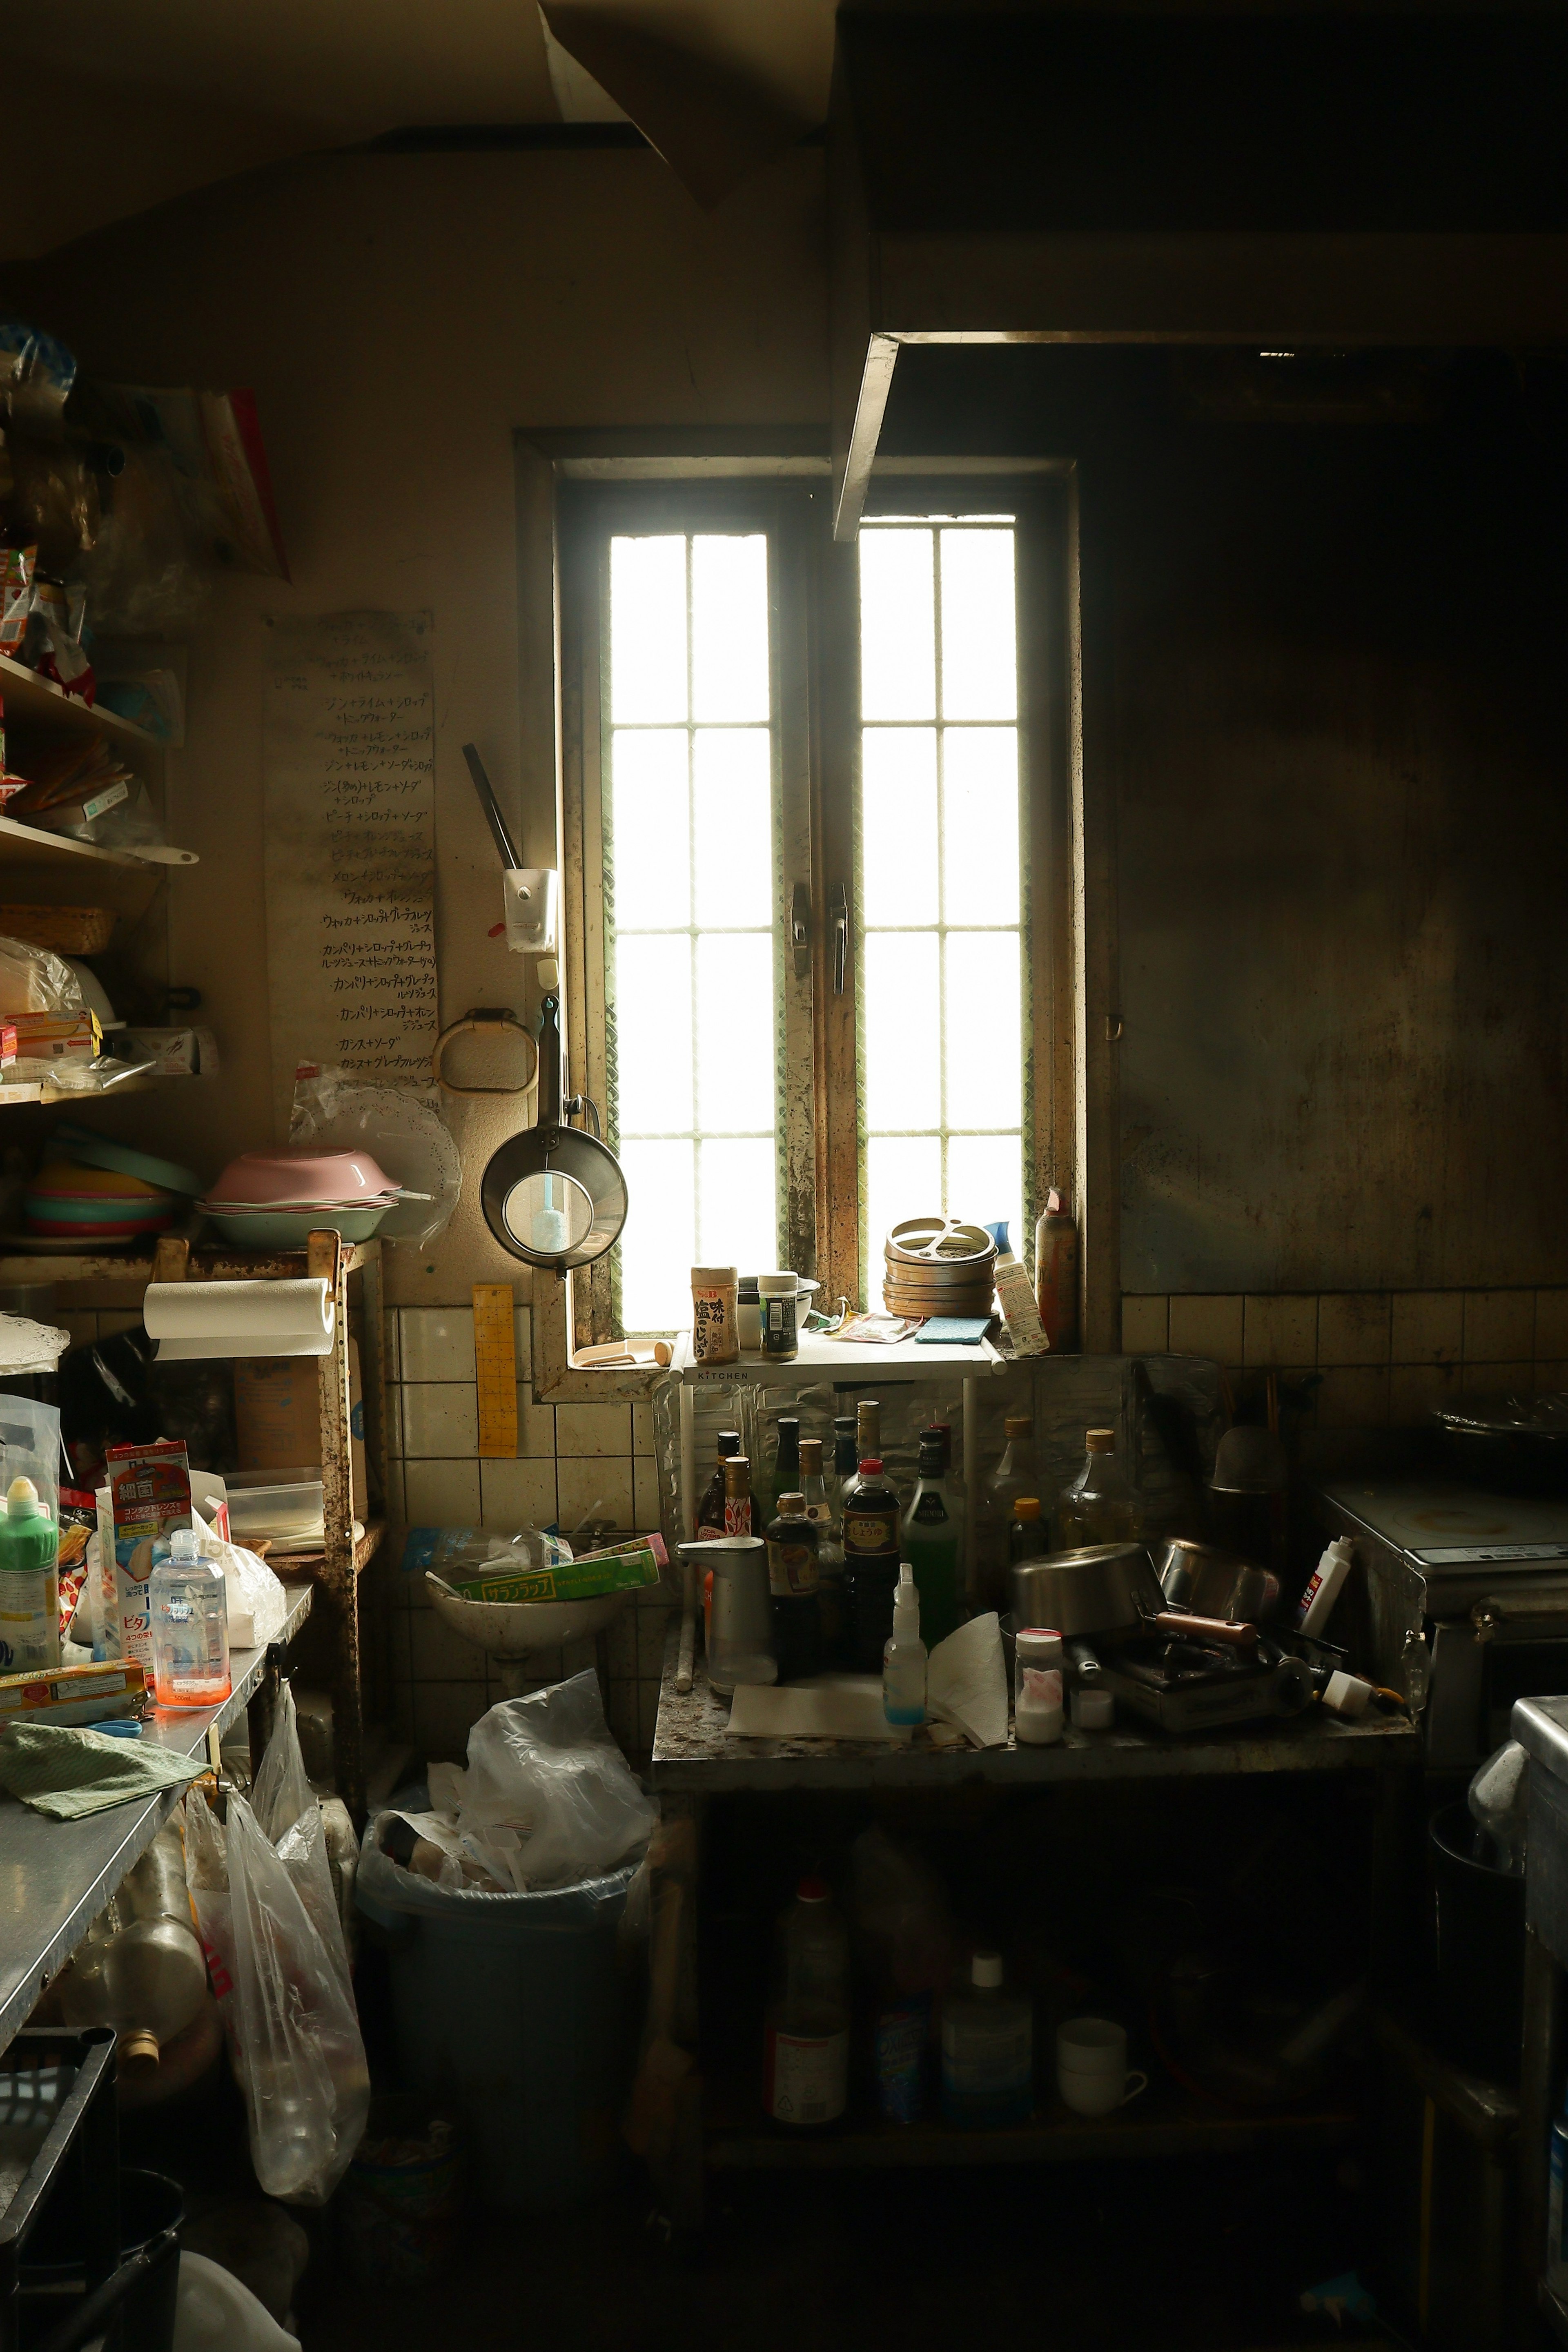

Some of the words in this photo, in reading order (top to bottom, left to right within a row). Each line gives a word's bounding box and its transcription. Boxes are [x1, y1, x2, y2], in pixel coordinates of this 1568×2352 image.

[339, 1036, 401, 1051] カシス+ソーダ
[709, 1298, 725, 1325] 味付
[118, 1479, 154, 1501] 細菌
[124, 1501, 182, 1516] コンタクトレンズを
[918, 1509, 944, 1518] MIDORI
[852, 1527, 883, 1537] しょうゆ
[488, 1577, 550, 1602] サランラップ
[126, 1630, 153, 1641] 4つの栄
